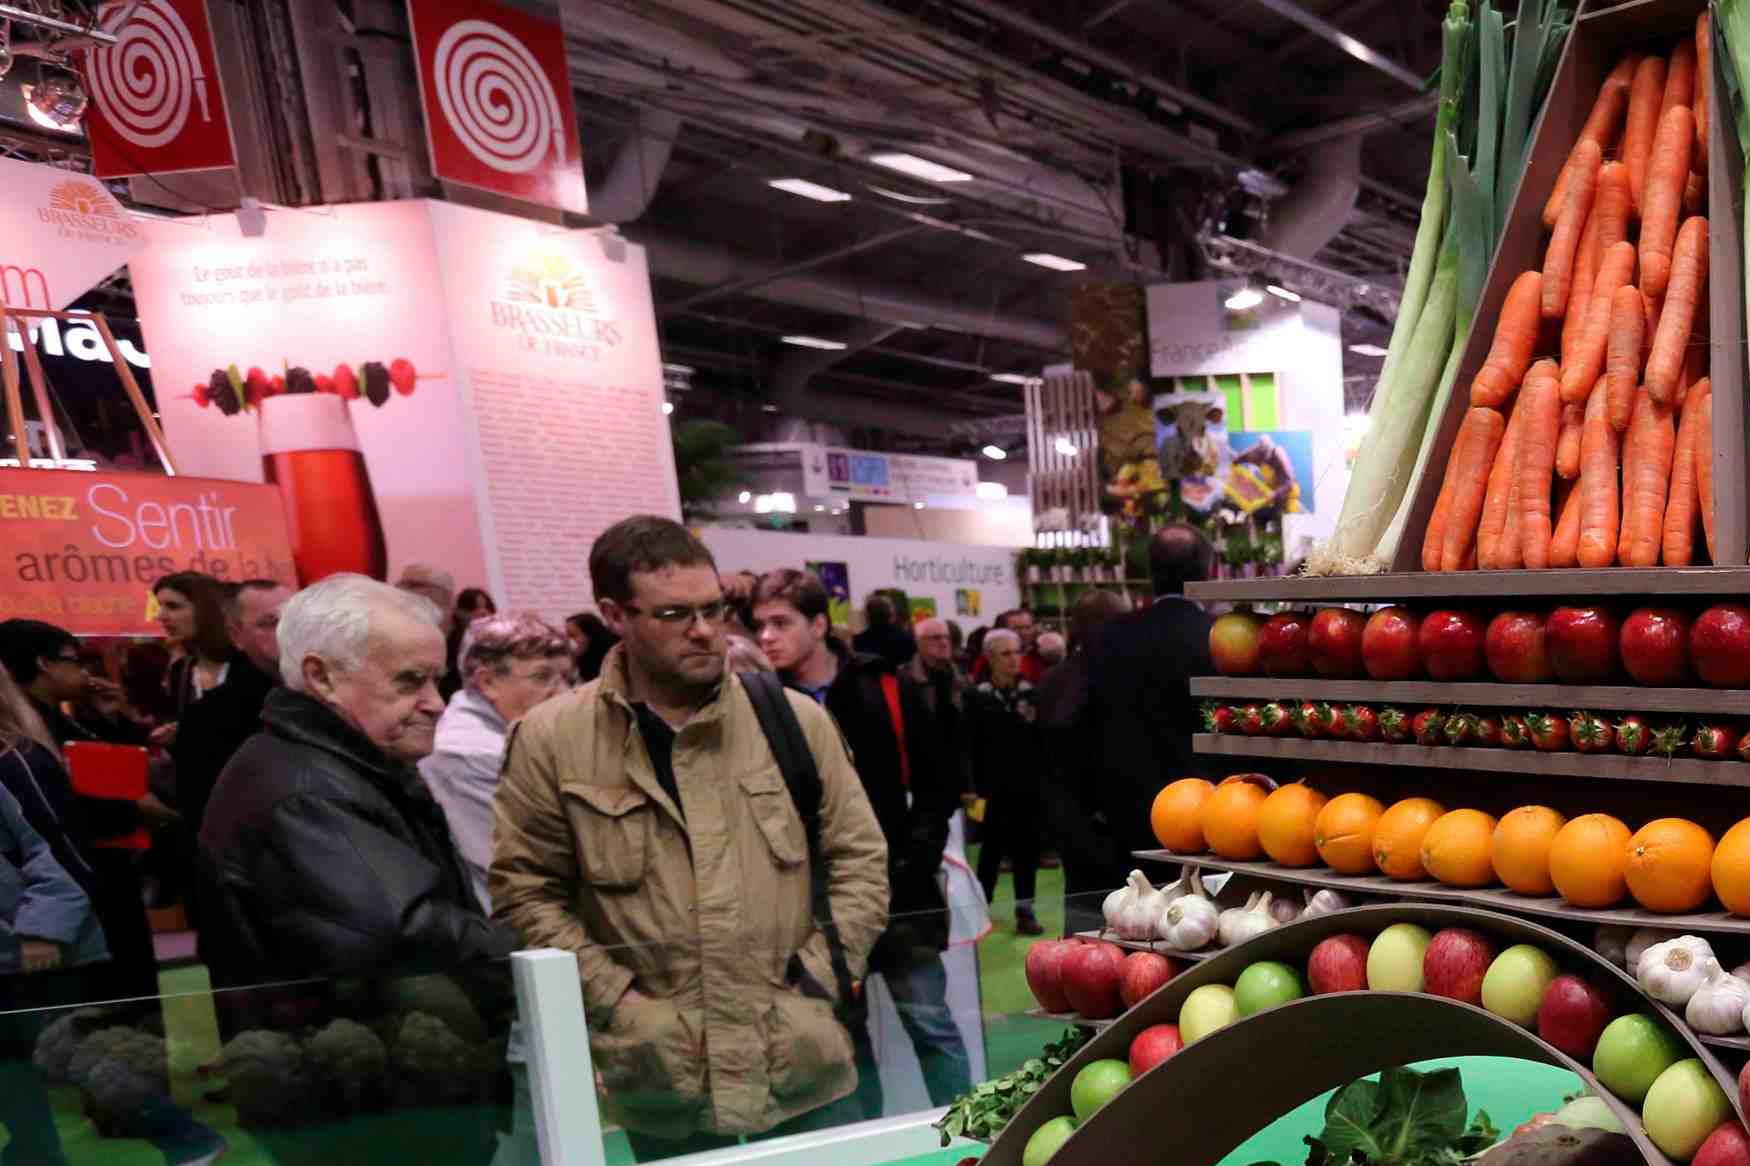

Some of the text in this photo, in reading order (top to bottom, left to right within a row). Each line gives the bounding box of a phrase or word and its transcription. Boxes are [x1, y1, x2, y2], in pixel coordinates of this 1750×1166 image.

[87, 482, 240, 550] Sentir
[15, 544, 176, 583] arômes
[892, 556, 1004, 585] Horticulture
